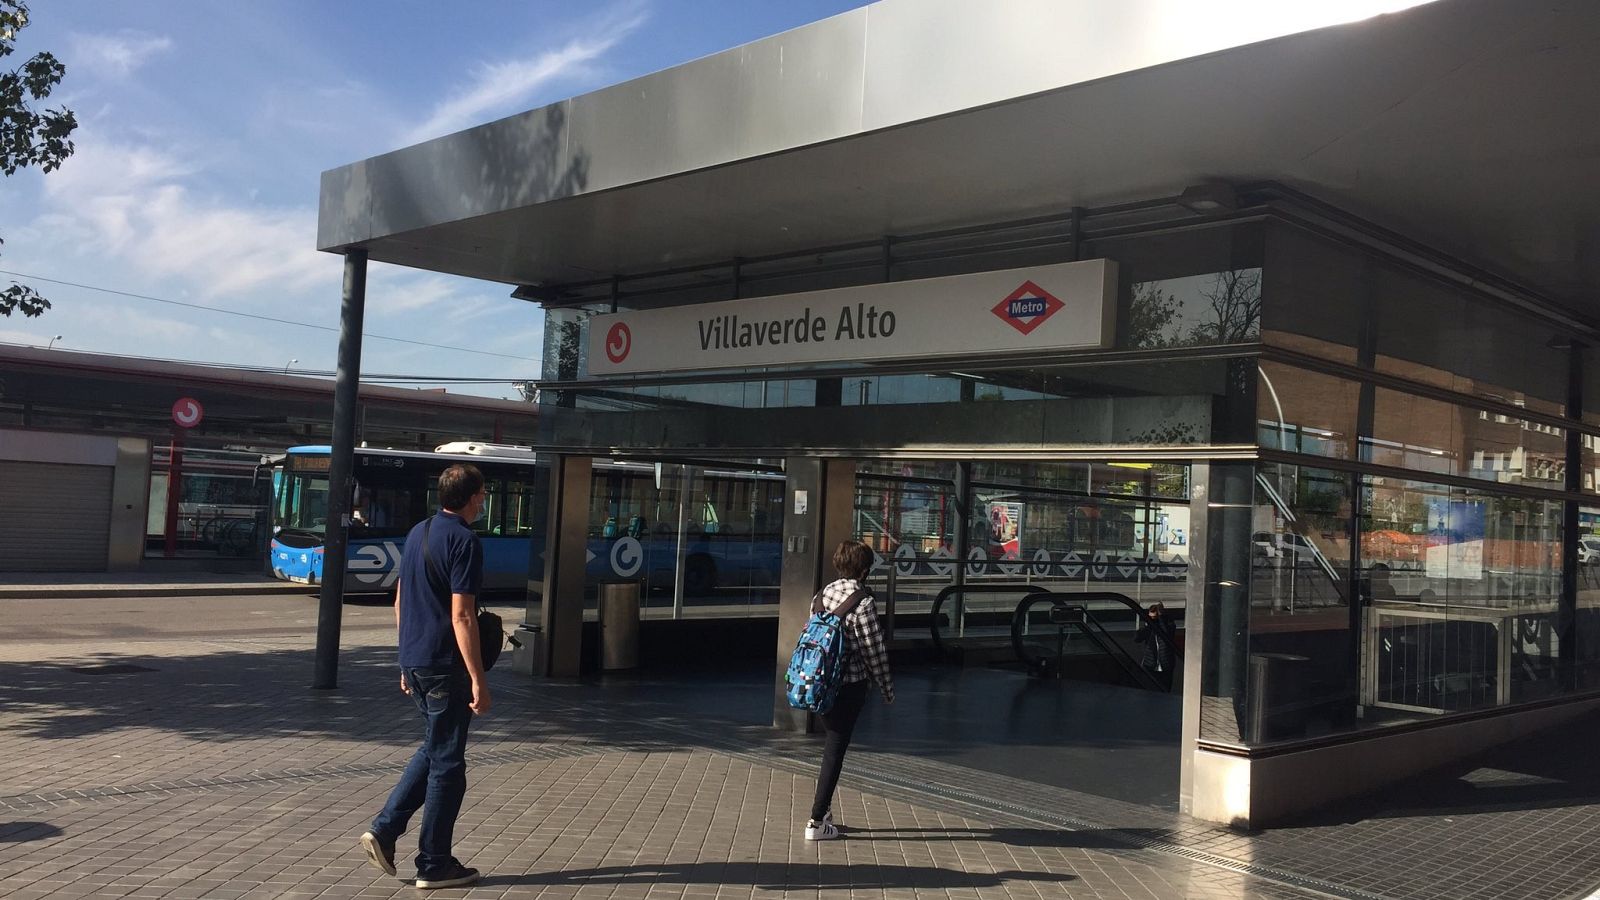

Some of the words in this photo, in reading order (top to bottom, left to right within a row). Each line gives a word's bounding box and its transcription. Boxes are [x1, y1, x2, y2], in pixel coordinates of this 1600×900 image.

[1011, 301, 1043, 314] Metro
[698, 307, 826, 351] Villaverde
[835, 302, 896, 341] Alto
